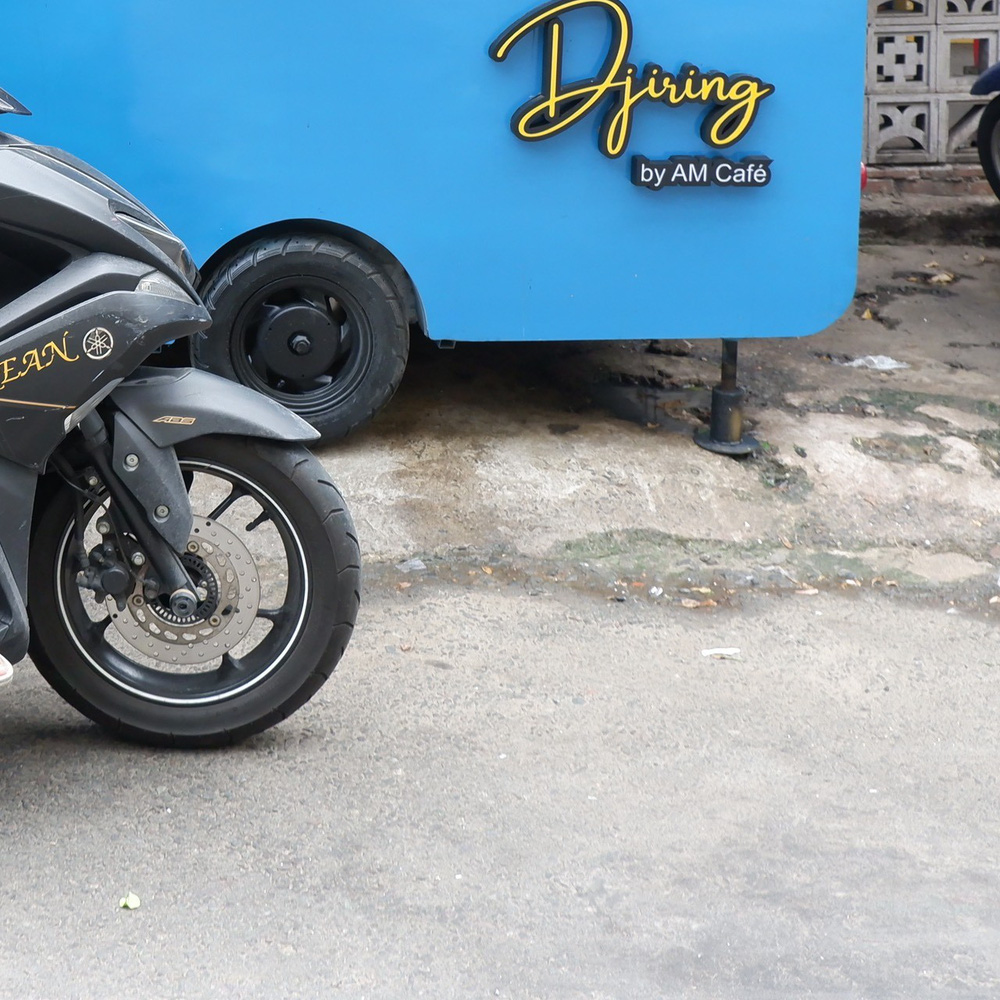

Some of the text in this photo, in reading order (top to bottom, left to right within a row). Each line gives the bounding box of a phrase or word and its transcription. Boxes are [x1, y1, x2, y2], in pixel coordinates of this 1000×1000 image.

[640, 162, 767, 187] by AM Café
